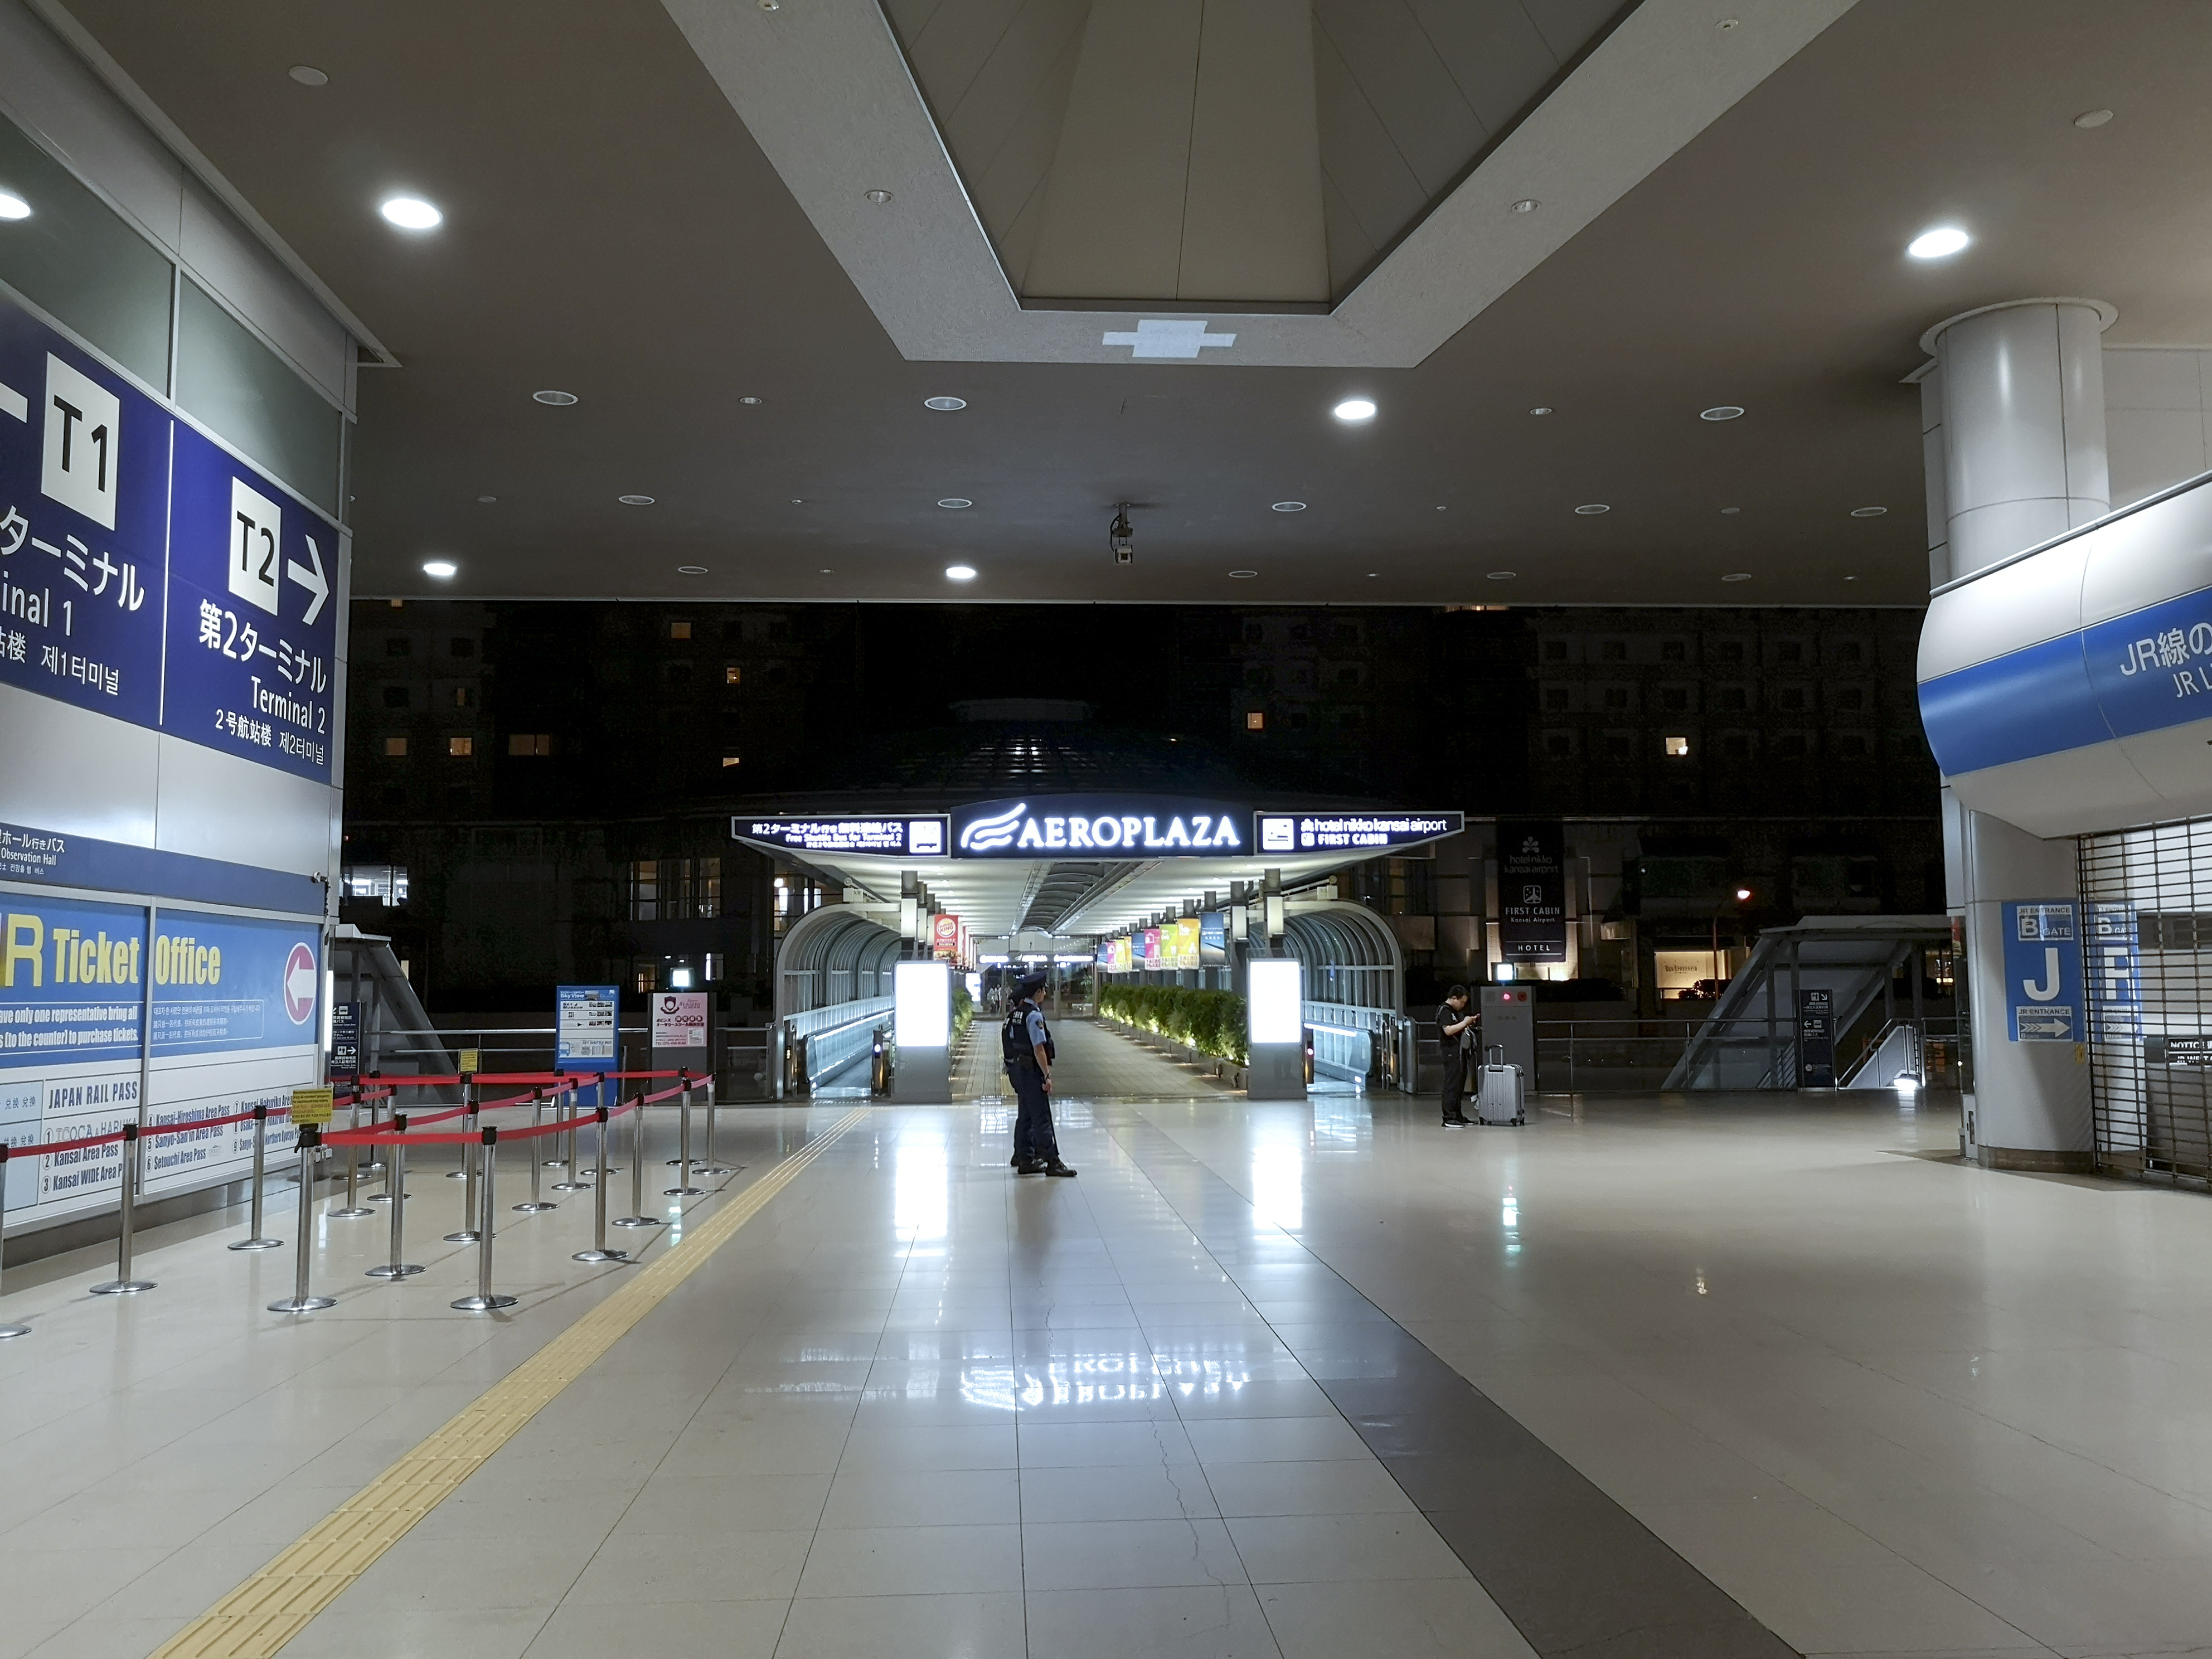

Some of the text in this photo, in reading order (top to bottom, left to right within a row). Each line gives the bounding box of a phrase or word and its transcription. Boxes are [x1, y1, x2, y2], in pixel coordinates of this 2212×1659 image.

[54, 394, 107, 492] T1
[237, 511, 275, 587] T2
[63, 600, 72, 636] 1
[199, 598, 327, 693] 第2ターミナル
[41, 645, 119, 696] 제1터미널
[2173, 671, 2200, 697] JR
[251, 676, 326, 735] Terminal 2
[279, 731, 324, 765] 제2터미널
[1017, 816, 1240, 848] AEROPLAZA
[1314, 818, 1447, 833] hotel nikko kansai airport
[1318, 833, 1388, 845] FIRST CABIN
[1, 847, 56, 865] Observation Hall
[2021, 918, 2039, 937] B
[0, 913, 221, 987] R Ticket Office
[2023, 948, 2060, 1001] J
[14, 1007, 33, 1024] only
[34, 1010, 50, 1022] one
[51, 1006, 108, 1023] representative
[108, 1006, 128, 1022] bring
[128, 1006, 138, 1020] all
[18, 1031, 32, 1047] the
[69, 1030, 77, 1044] to
[77, 1029, 113, 1045] purchase
[113, 1027, 138, 1042] tickets.
[48, 1080, 138, 1109] JAPAN RAIL PASS
[205, 1106, 217, 1119] Area
[218, 1104, 230, 1117] Pass
[195, 1127, 210, 1141] Area
[210, 1126, 224, 1138] Pass
[54, 1148, 81, 1167] Kansai
[83, 1147, 100, 1162] Area
[101, 1143, 119, 1158] Pass
[154, 1151, 180, 1170] Setouchi
[180, 1151, 193, 1165] Area
[193, 1148, 207, 1161] Pass
[53, 1171, 79, 1191] Kansai
[81, 1167, 99, 1186] WIDE
[100, 1166, 117, 1181] Area
